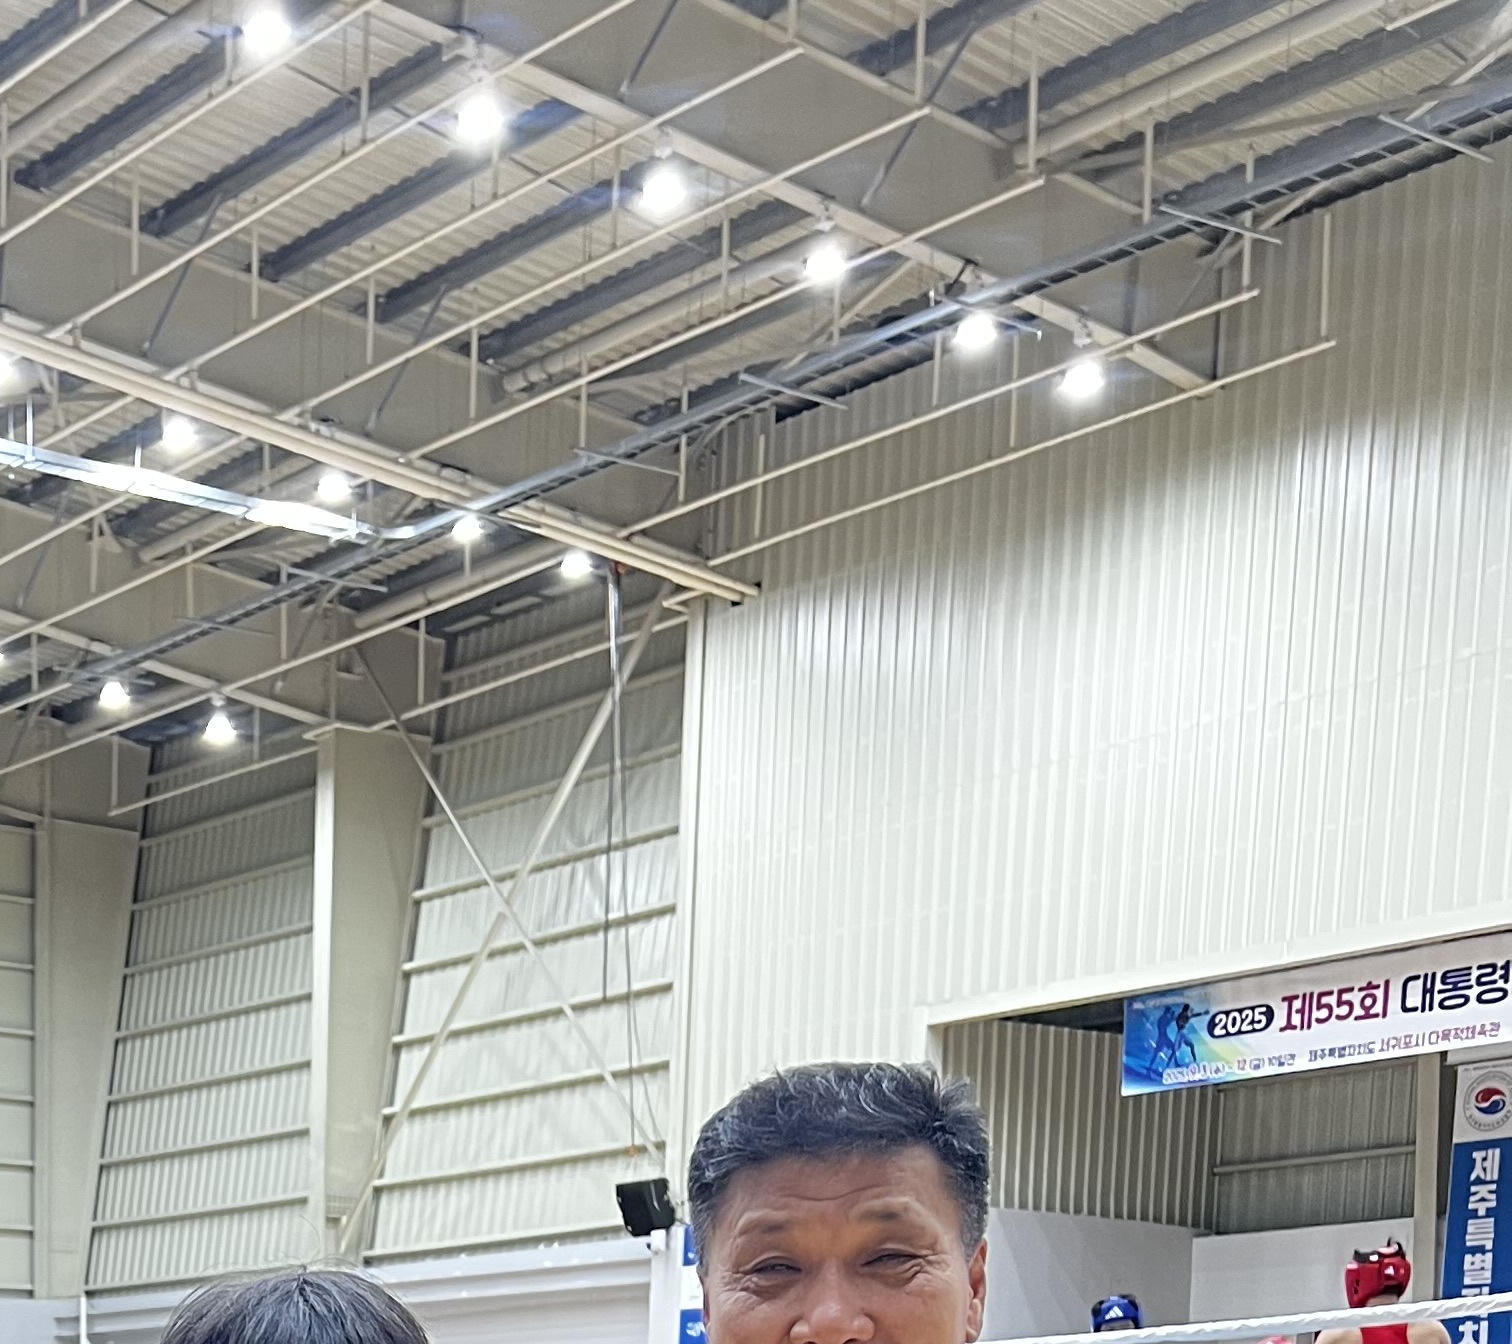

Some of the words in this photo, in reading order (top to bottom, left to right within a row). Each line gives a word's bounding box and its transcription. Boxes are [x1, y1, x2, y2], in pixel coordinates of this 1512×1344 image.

[1213, 1007, 1267, 1036] 2025
[1279, 979, 1390, 1033] 제55회
[1400, 959, 1511, 1014] 대통령
